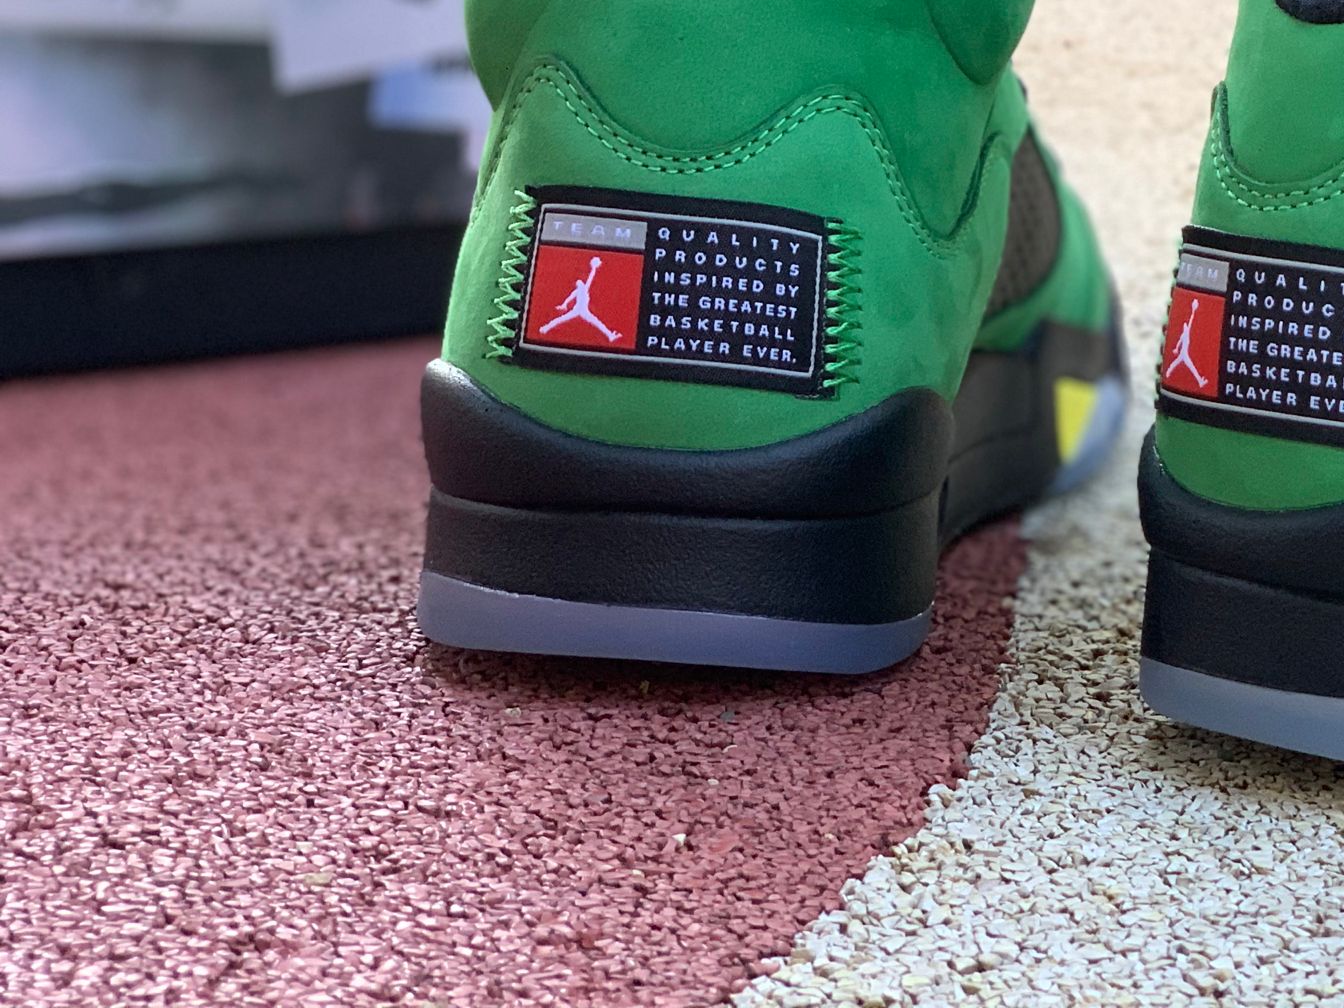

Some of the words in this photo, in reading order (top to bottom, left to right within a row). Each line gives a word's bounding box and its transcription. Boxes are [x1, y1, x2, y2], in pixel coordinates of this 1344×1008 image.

[553, 220, 632, 239] TEAM
[657, 226, 800, 255] QUALITY
[655, 248, 800, 277] PRODUCTS
[653, 270, 764, 294] INSPIRED
[775, 283, 799, 299] BY
[652, 292, 689, 308] THE
[699, 296, 798, 320] GREATEST
[649, 314, 795, 341] BASKETBALL
[1230, 314, 1331, 340] INSPIRED
[647, 335, 730, 355] PLAYER
[743, 344, 797, 363] EVER.
[1229, 337, 1259, 353] THE
[1225, 383, 1297, 406] PLAYER
